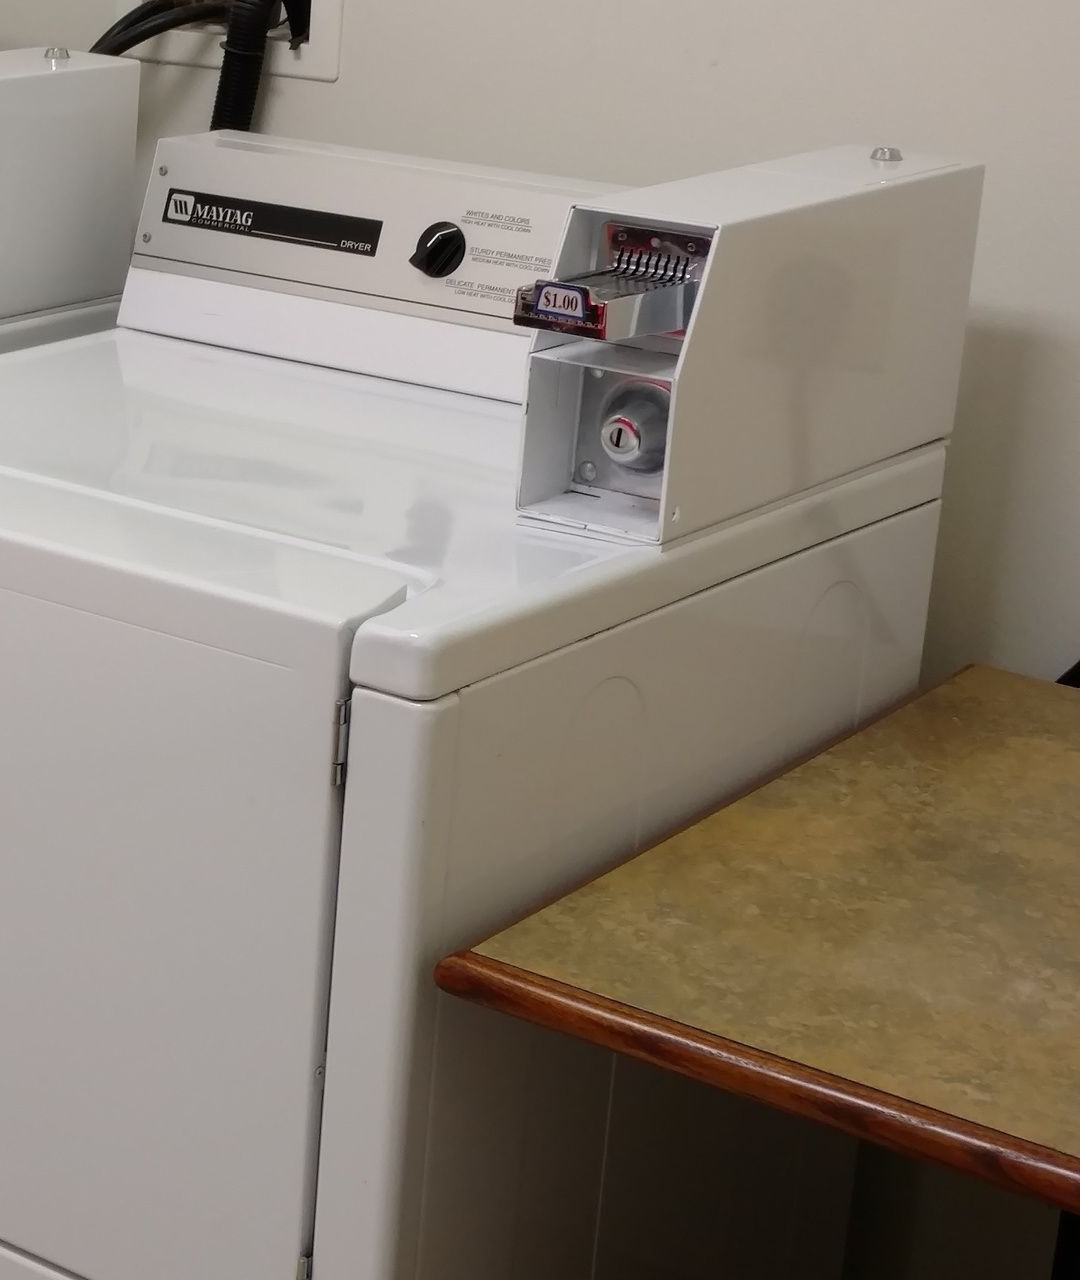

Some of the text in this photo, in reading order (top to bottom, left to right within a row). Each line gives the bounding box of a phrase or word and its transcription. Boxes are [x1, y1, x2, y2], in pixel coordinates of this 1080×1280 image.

[192, 203, 254, 226] MAYTAG
[191, 218, 250, 232] COMMERCIAL
[340, 239, 372, 252] DRYER
[534, 256, 552, 266] PRES
[543, 290, 579, 312] $1.00
